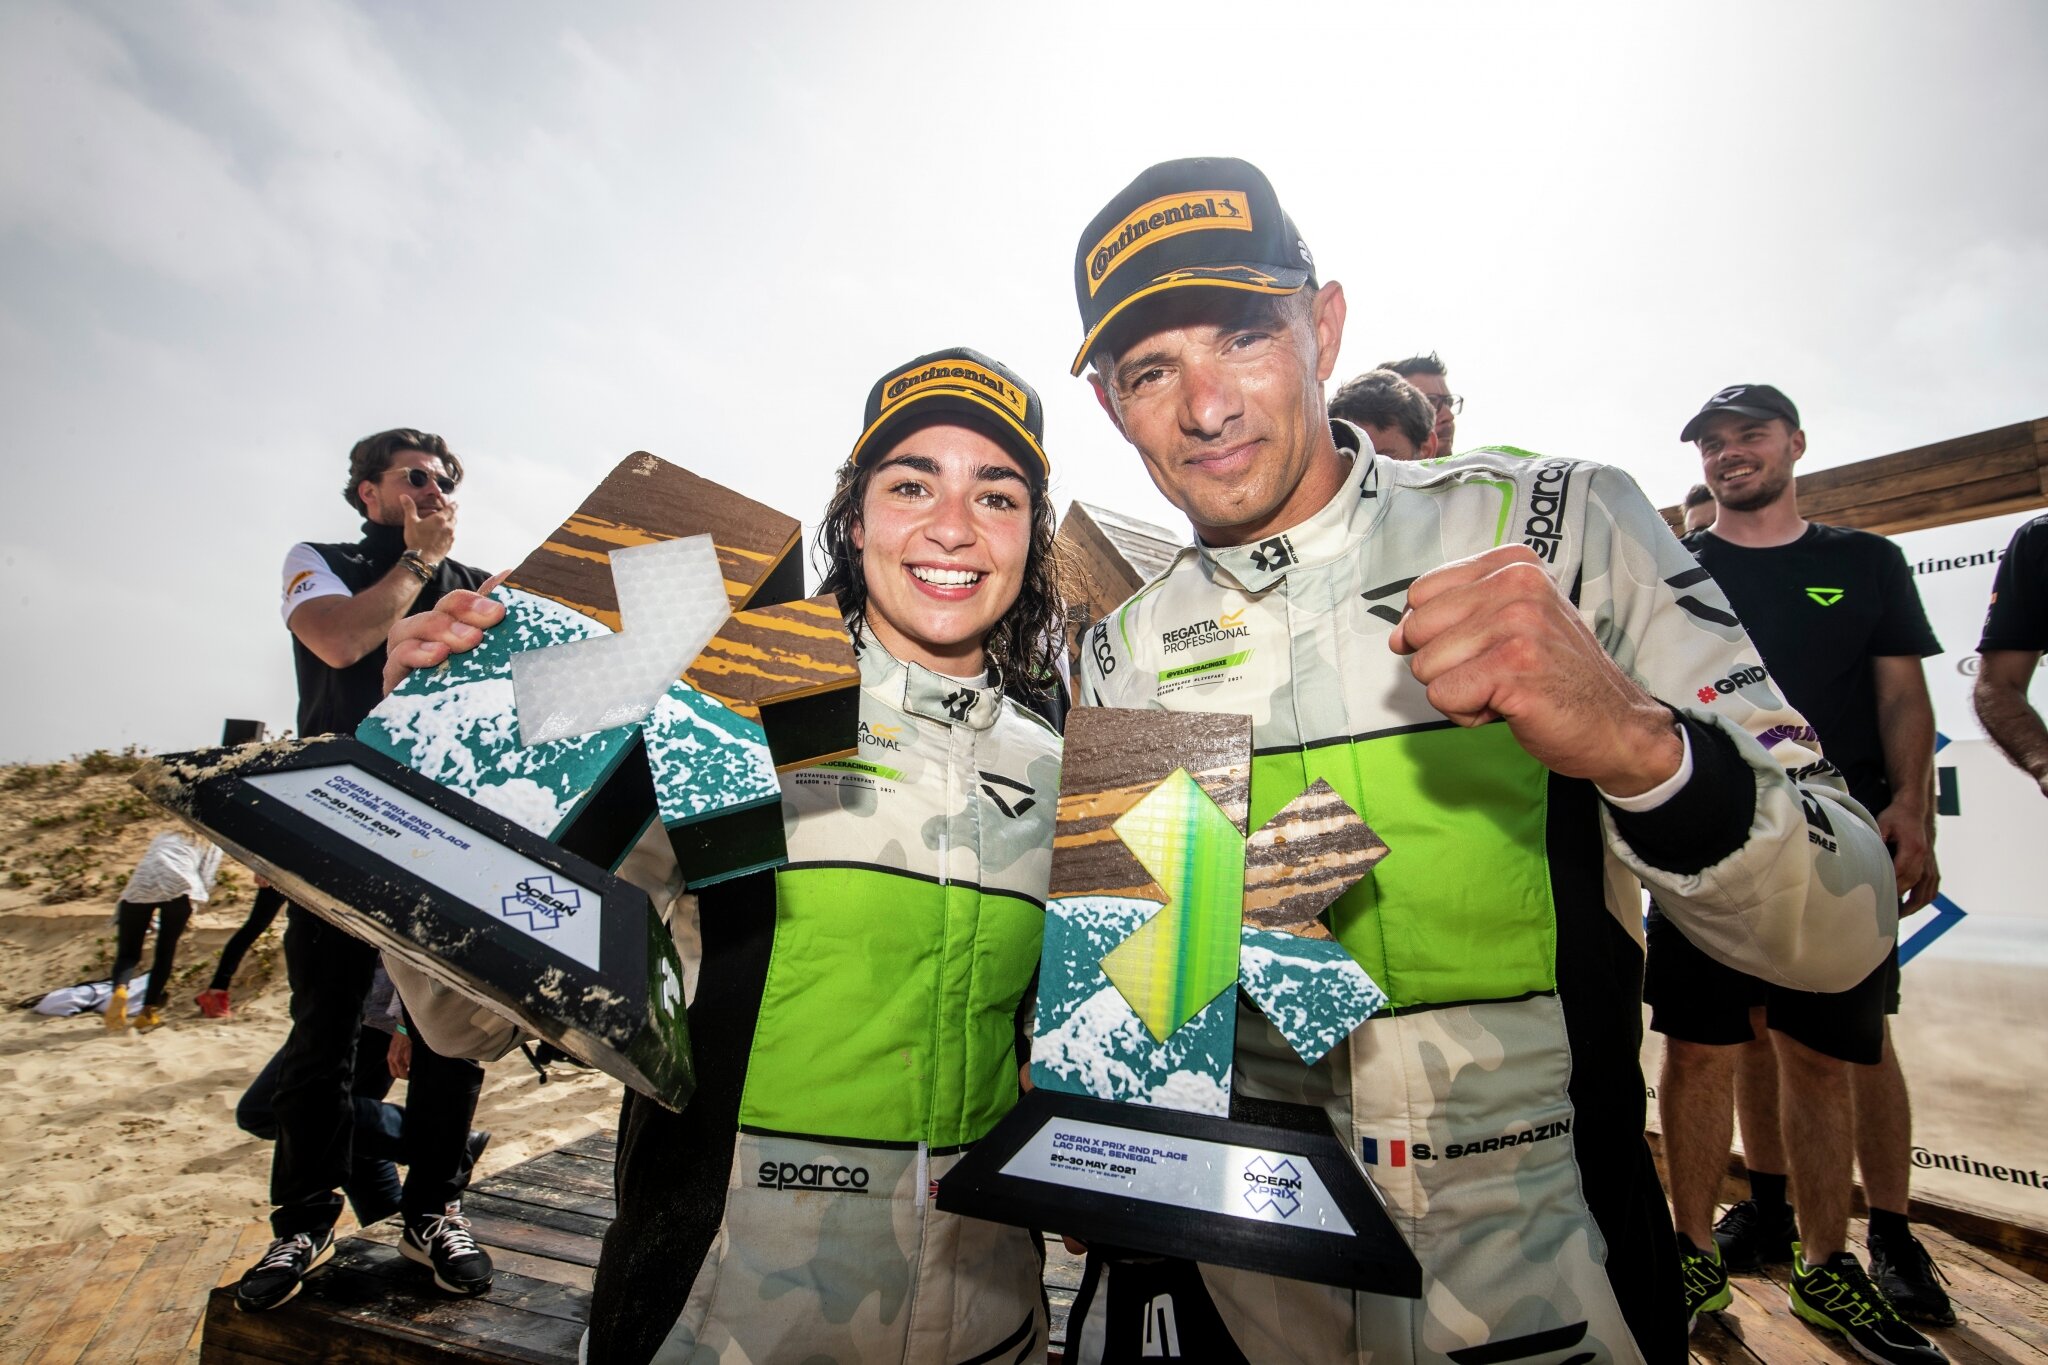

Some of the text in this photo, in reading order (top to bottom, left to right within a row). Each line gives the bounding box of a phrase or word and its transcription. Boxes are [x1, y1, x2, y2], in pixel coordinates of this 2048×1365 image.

[1091, 199, 1219, 281] Continental
[887, 366, 1006, 399] Continental
[1162, 619, 1219, 645] REGATTA
[1163, 626, 1250, 655] PROFESSIONAL
[324, 780, 349, 794] LAC
[347, 792, 380, 813] ROSE,
[381, 810, 430, 840] SENEGAL
[333, 775, 373, 798] OCEAN
[381, 801, 409, 817] PRIX
[408, 815, 433, 830] 2ND
[432, 828, 471, 850] PLACE
[346, 807, 373, 821] MAY
[371, 820, 402, 838] 2021
[516, 882, 577, 917] OCEAN
[1053, 1141, 1157, 1165] LAC ROSE, SENEGAL
[1054, 1132, 1188, 1161] OCEAN X PRIX 2ND PLACE
[1411, 1118, 1571, 1160] S. SARRAZIN
[758, 1161, 870, 1192] sparco
[1085, 1160, 1108, 1170] MAY
[1109, 1164, 1136, 1175] 2021
[1243, 1172, 1302, 1190] OCEAN
[1911, 1146, 2048, 1191] Continent
[1249, 1184, 1297, 1199] XPRIX
